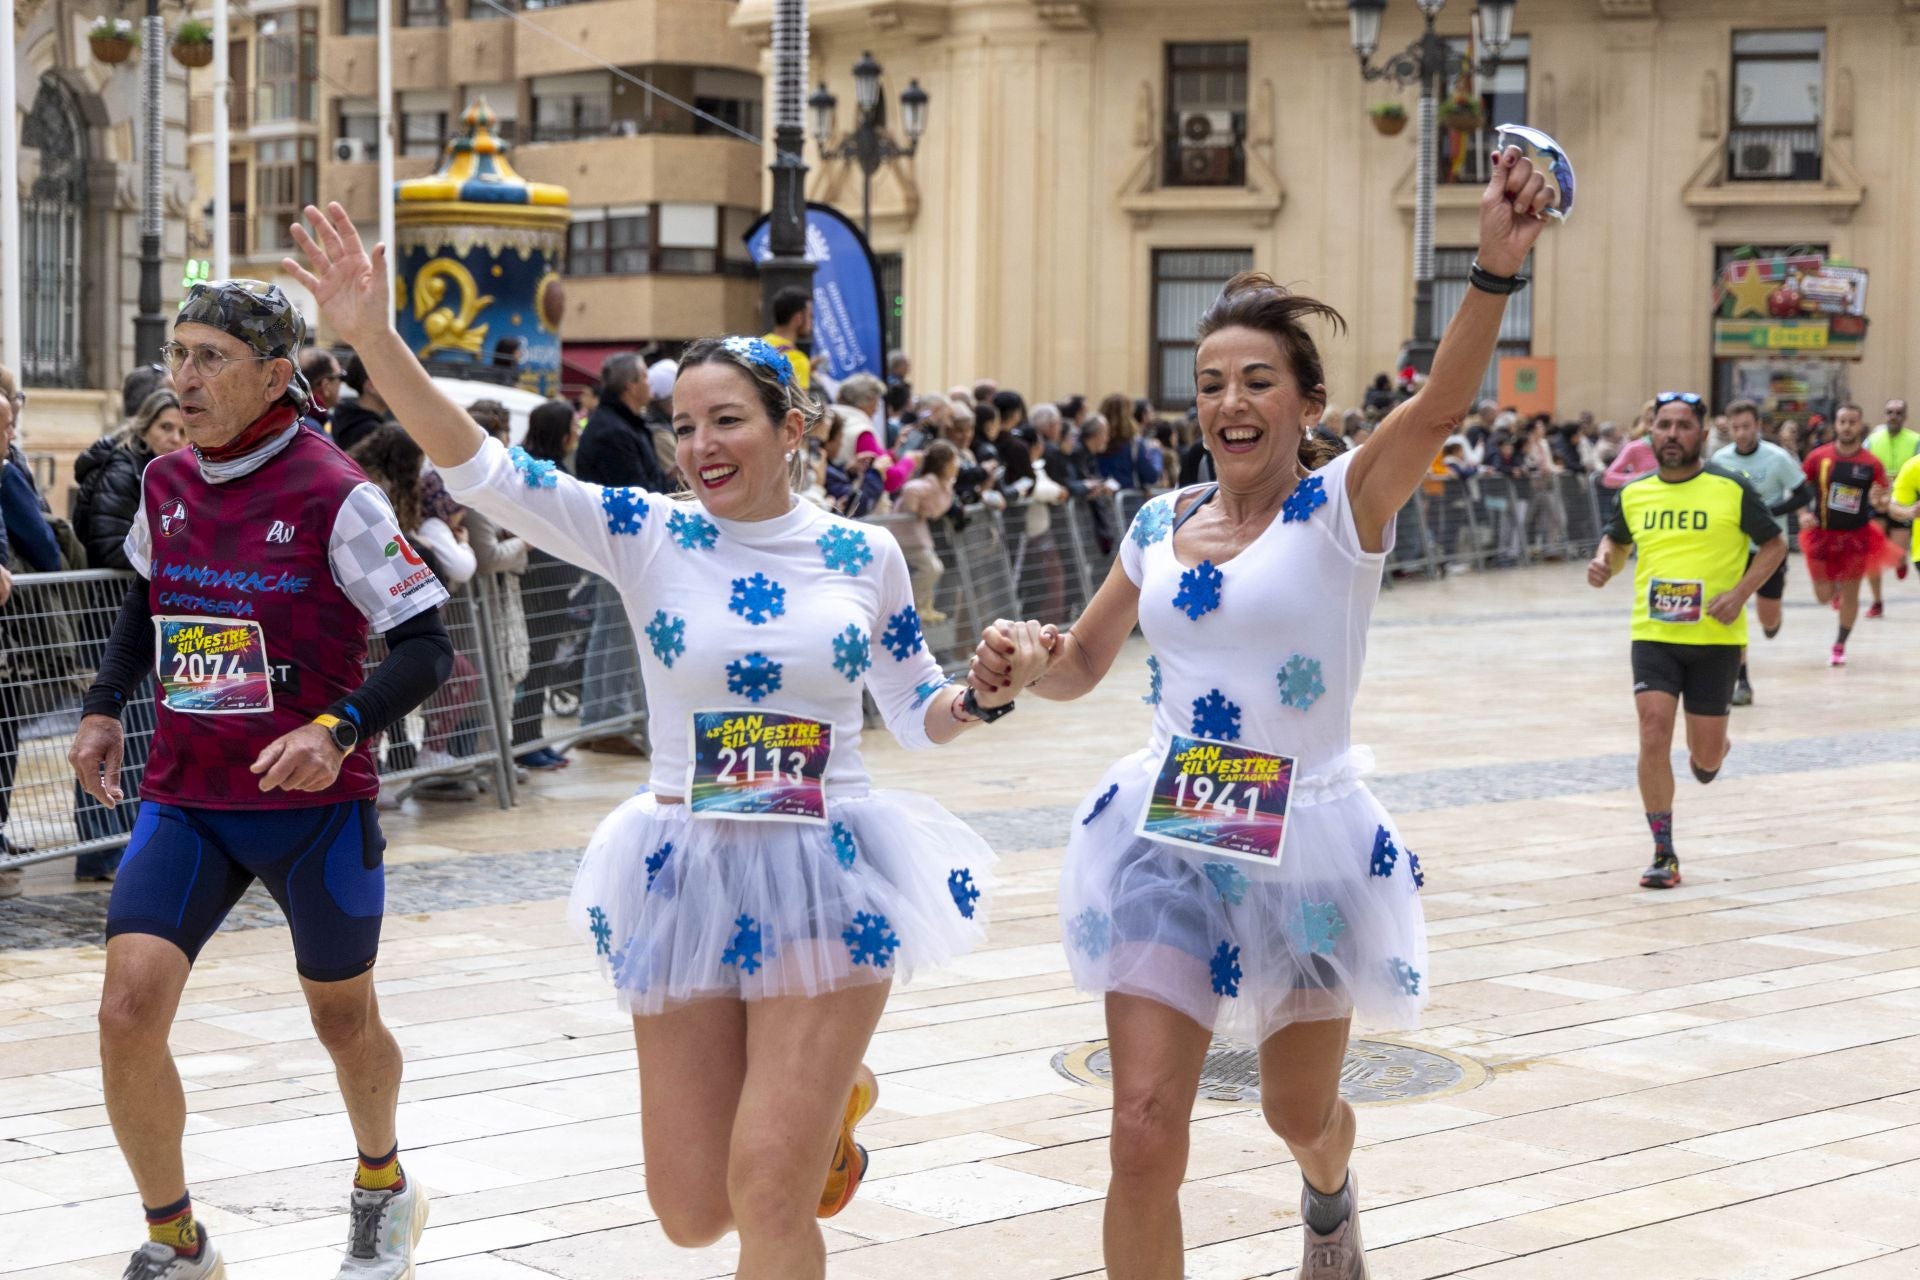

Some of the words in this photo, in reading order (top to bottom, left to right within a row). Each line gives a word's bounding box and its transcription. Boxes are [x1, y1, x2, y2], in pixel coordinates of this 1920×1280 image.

[1643, 510, 1708, 530] UNED
[162, 562, 311, 594] MANDARACHE
[158, 591, 255, 616] CARTAGENA
[178, 627, 251, 654] SILVESTRE
[179, 626, 205, 642] SAN
[205, 640, 252, 655] CARTAGENA
[172, 652, 248, 684] 2074
[721, 723, 821, 749] SILVESTRE
[722, 715, 763, 736] SAN
[764, 738, 820, 749] CARTAGENA
[1186, 745, 1222, 761] SAN
[716, 746, 807, 786] 2113
[1182, 758, 1282, 775] SILVESTRE
[1218, 773, 1279, 783] CARTAGENA
[1174, 770, 1260, 822] 1941
